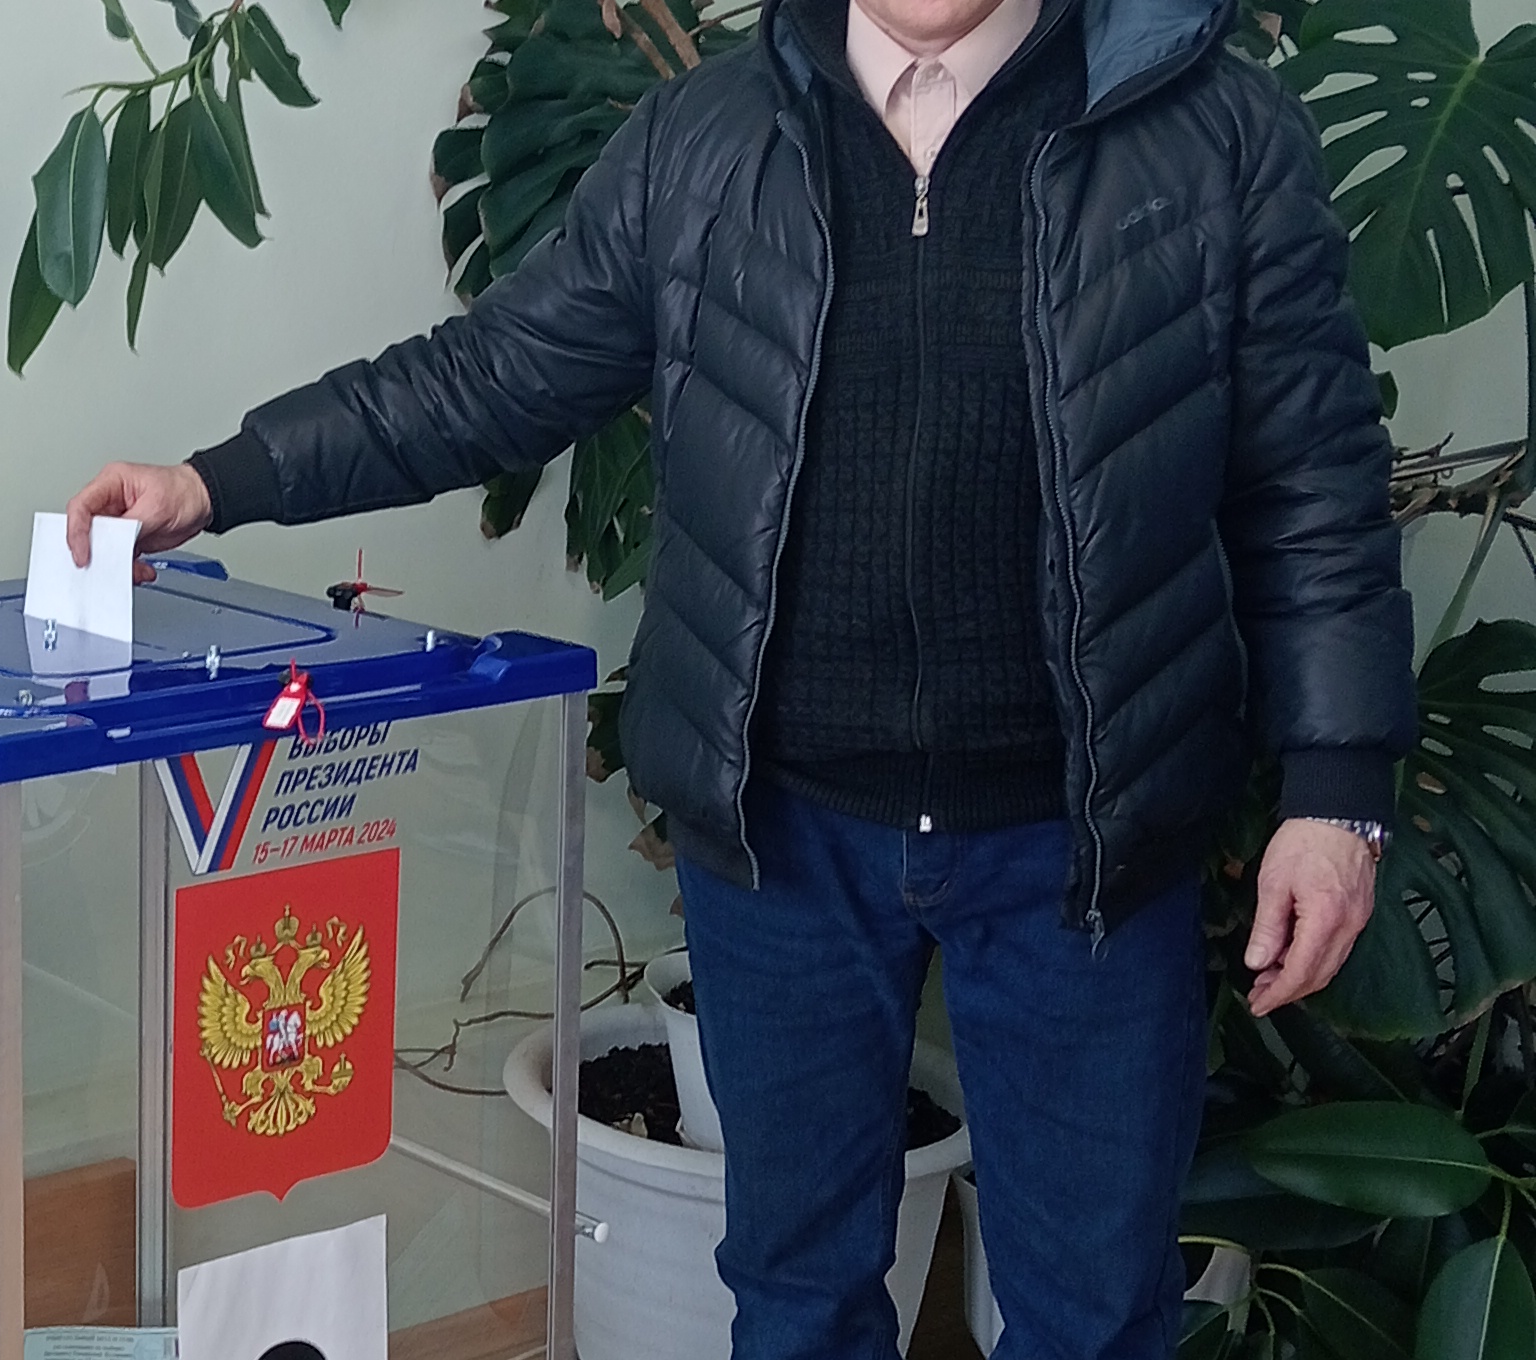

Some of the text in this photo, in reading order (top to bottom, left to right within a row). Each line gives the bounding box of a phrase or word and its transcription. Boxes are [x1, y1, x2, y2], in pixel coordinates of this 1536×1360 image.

[274, 748, 419, 797] ПРЕЗИДЕНТА
[261, 793, 357, 833] РОССИИ
[299, 826, 355, 854] МАРТА
[357, 818, 397, 844] 2024
